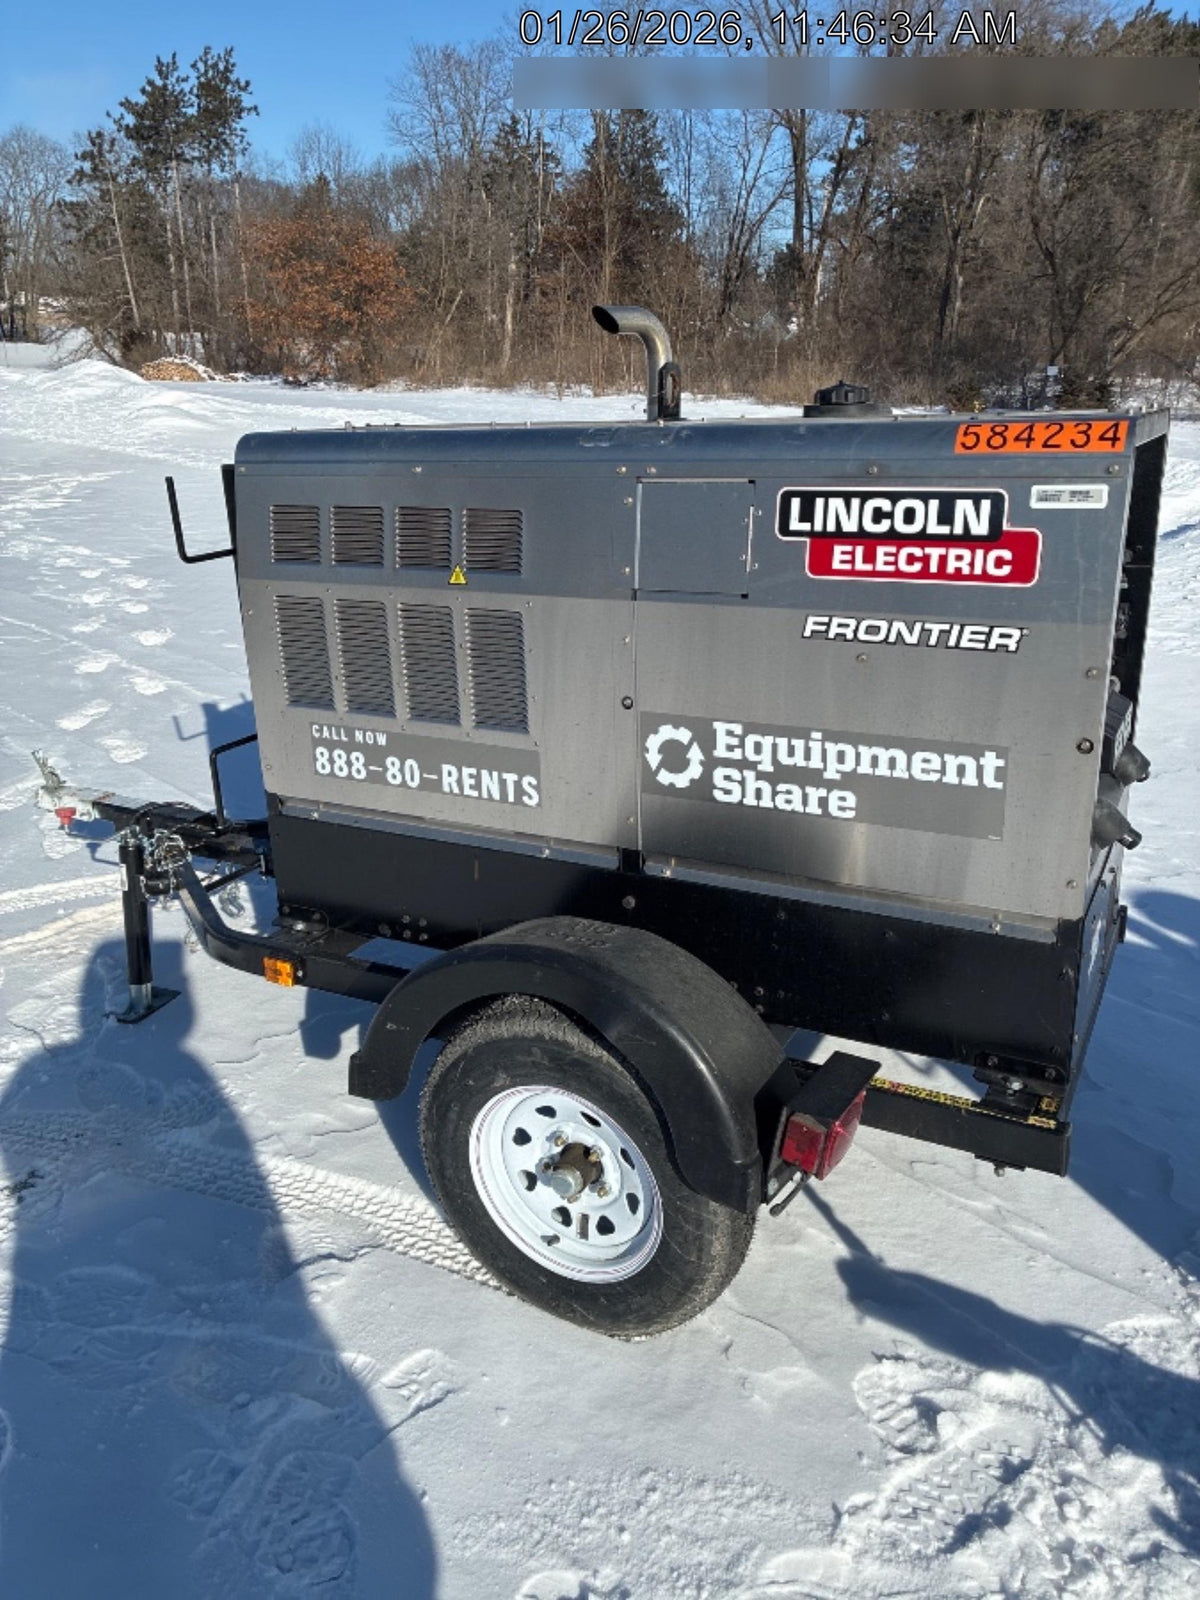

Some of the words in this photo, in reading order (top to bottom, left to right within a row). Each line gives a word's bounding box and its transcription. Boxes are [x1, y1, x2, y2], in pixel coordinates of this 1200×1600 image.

[959, 421, 1122, 450] 584234
[788, 496, 992, 536] LINCOLN
[831, 544, 1014, 577] ELECTRIC
[311, 724, 349, 742] CALL
[354, 729, 388, 747] NOW
[711, 720, 1006, 790] Equipment
[314, 745, 541, 808] 888-80-RENTS
[711, 765, 858, 820] Share
